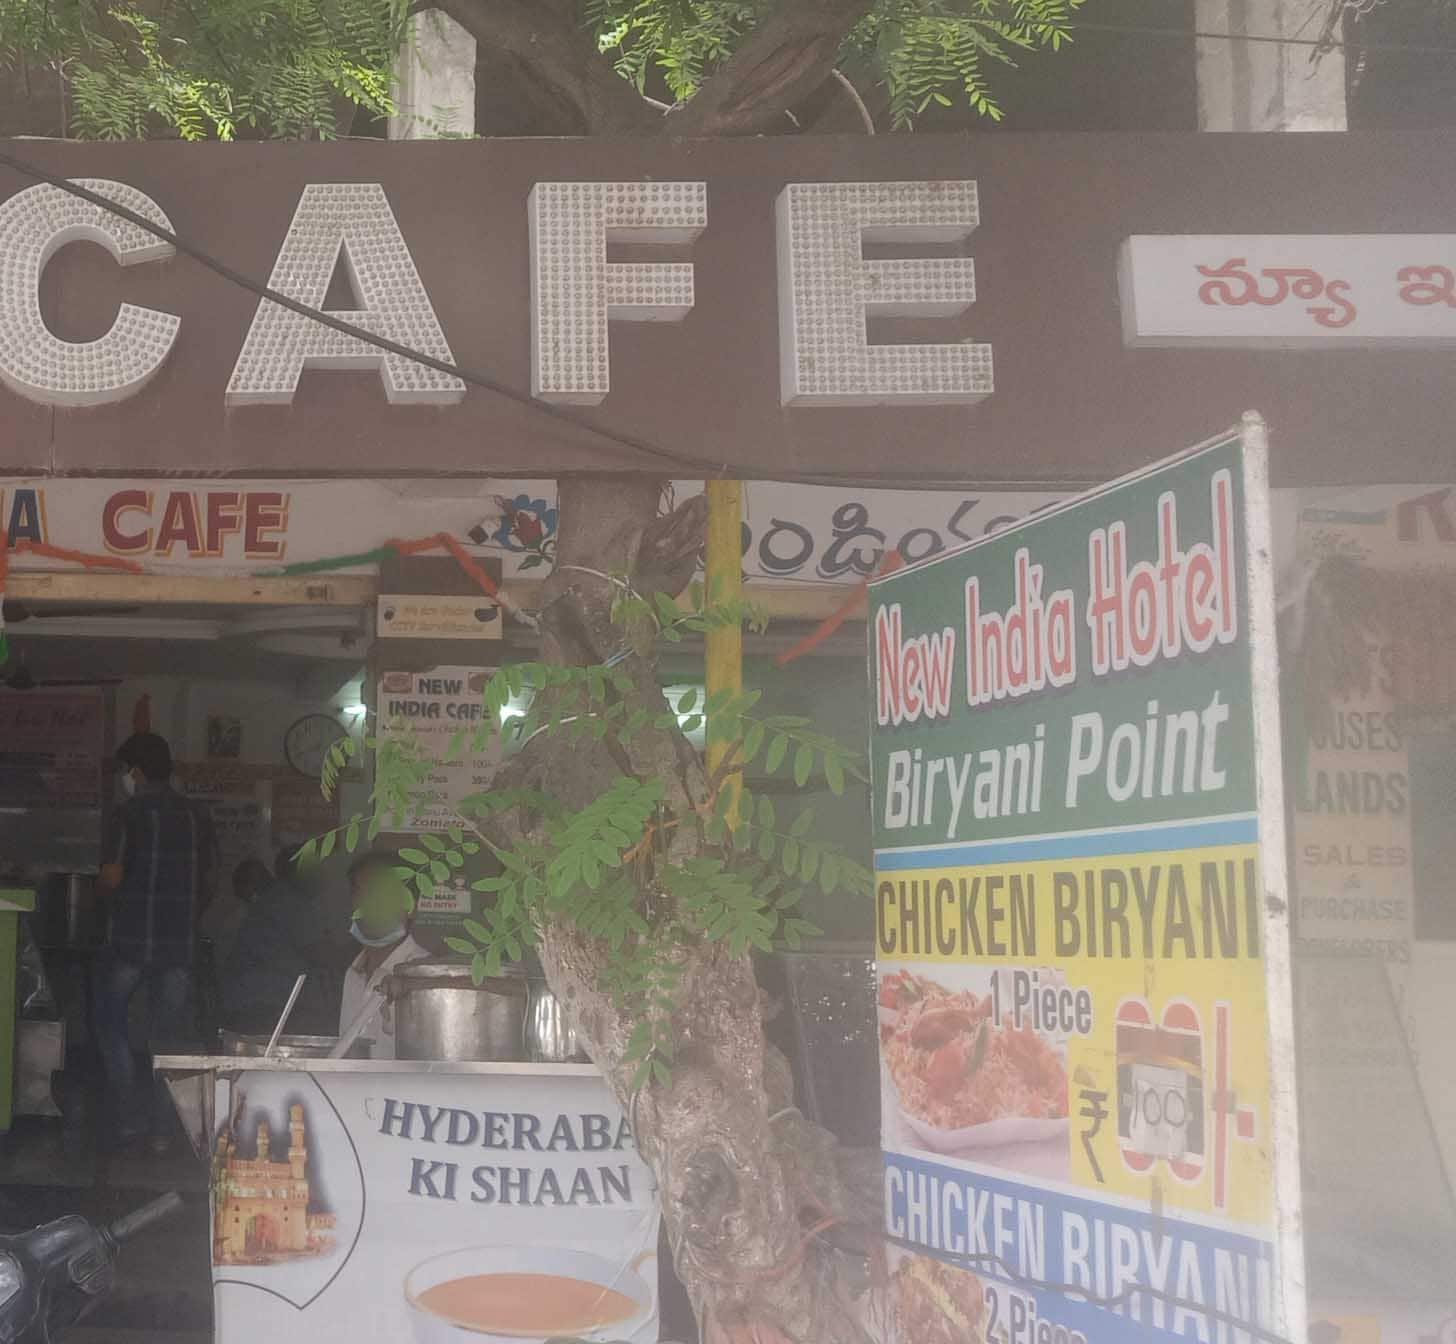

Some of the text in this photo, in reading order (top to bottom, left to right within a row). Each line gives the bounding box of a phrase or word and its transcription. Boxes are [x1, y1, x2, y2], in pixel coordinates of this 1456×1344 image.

[101, 489, 290, 561] CAFE
[875, 467, 1238, 726] New India Hotel
[388, 700, 440, 719] INDIA
[418, 679, 463, 695] NEW
[884, 689, 1229, 839] Biryani Point
[1303, 843, 1409, 867] SALES
[877, 858, 1260, 959] CHICKEN BIRYANI
[1301, 896, 1408, 921] PURCHASE
[989, 968, 1092, 1034] 1 Piece
[377, 1098, 635, 1153] HYDERABA
[407, 1157, 635, 1207] KI SHAAN
[884, 1165, 1272, 1344] CHICKEN BIRYANI
